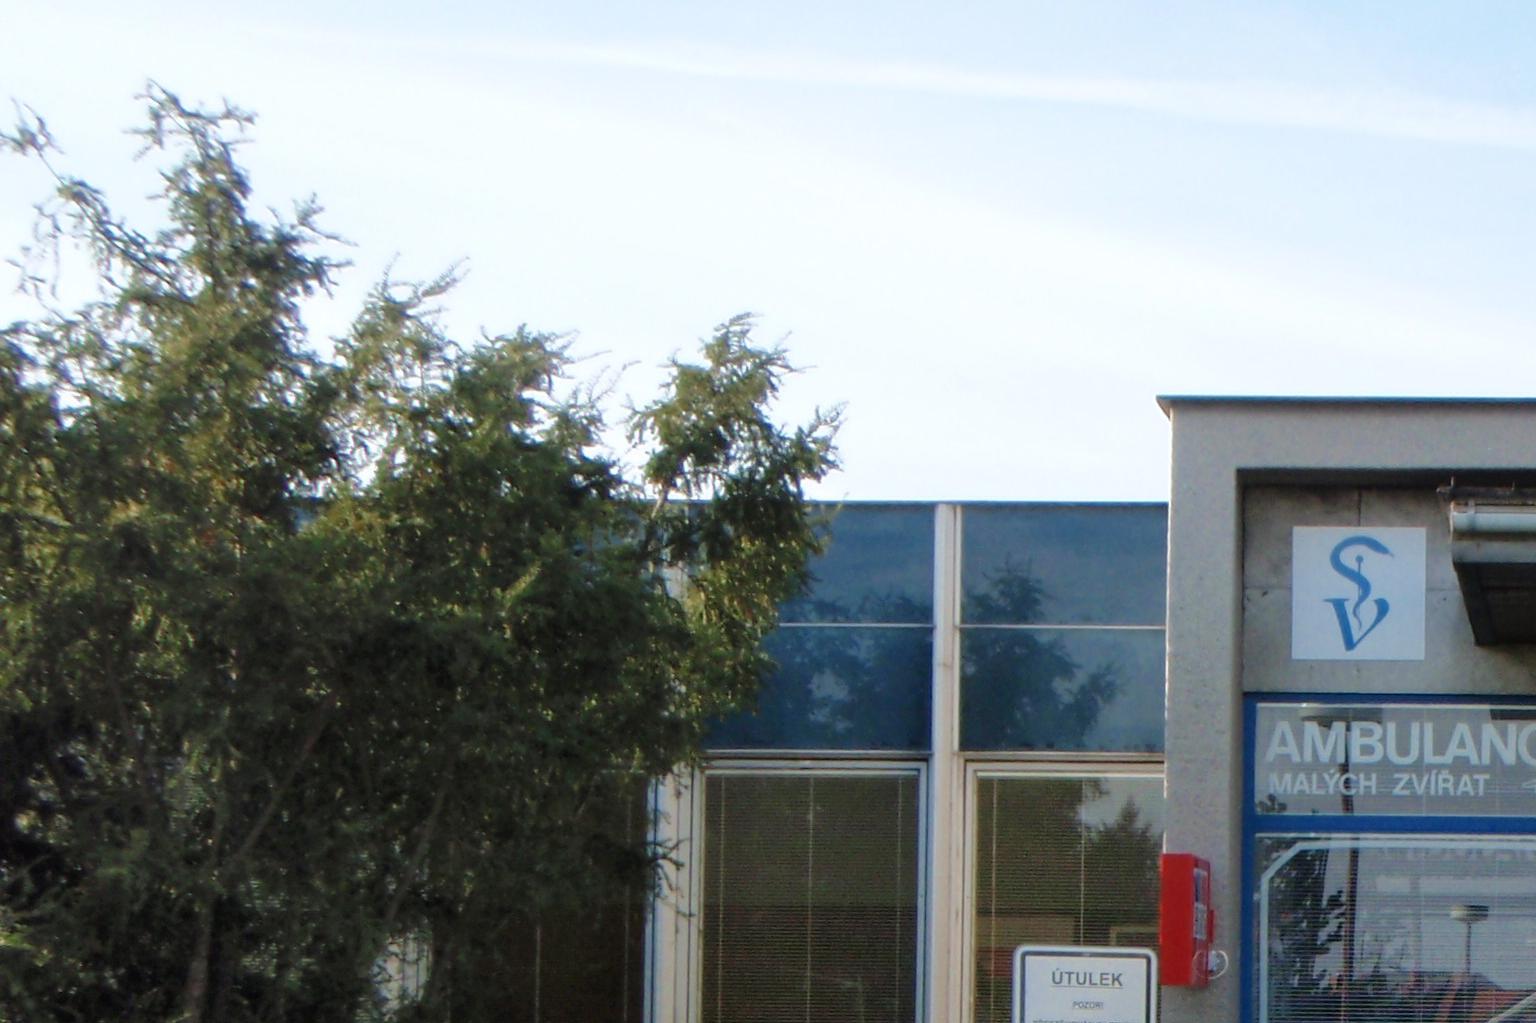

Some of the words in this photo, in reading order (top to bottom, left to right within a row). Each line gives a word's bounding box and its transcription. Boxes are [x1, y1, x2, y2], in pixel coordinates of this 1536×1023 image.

[1268, 768, 1377, 796] MALÝCH
[1391, 768, 1491, 797] ZVÍŘAT
[1051, 967, 1124, 987] ÚTULEK
